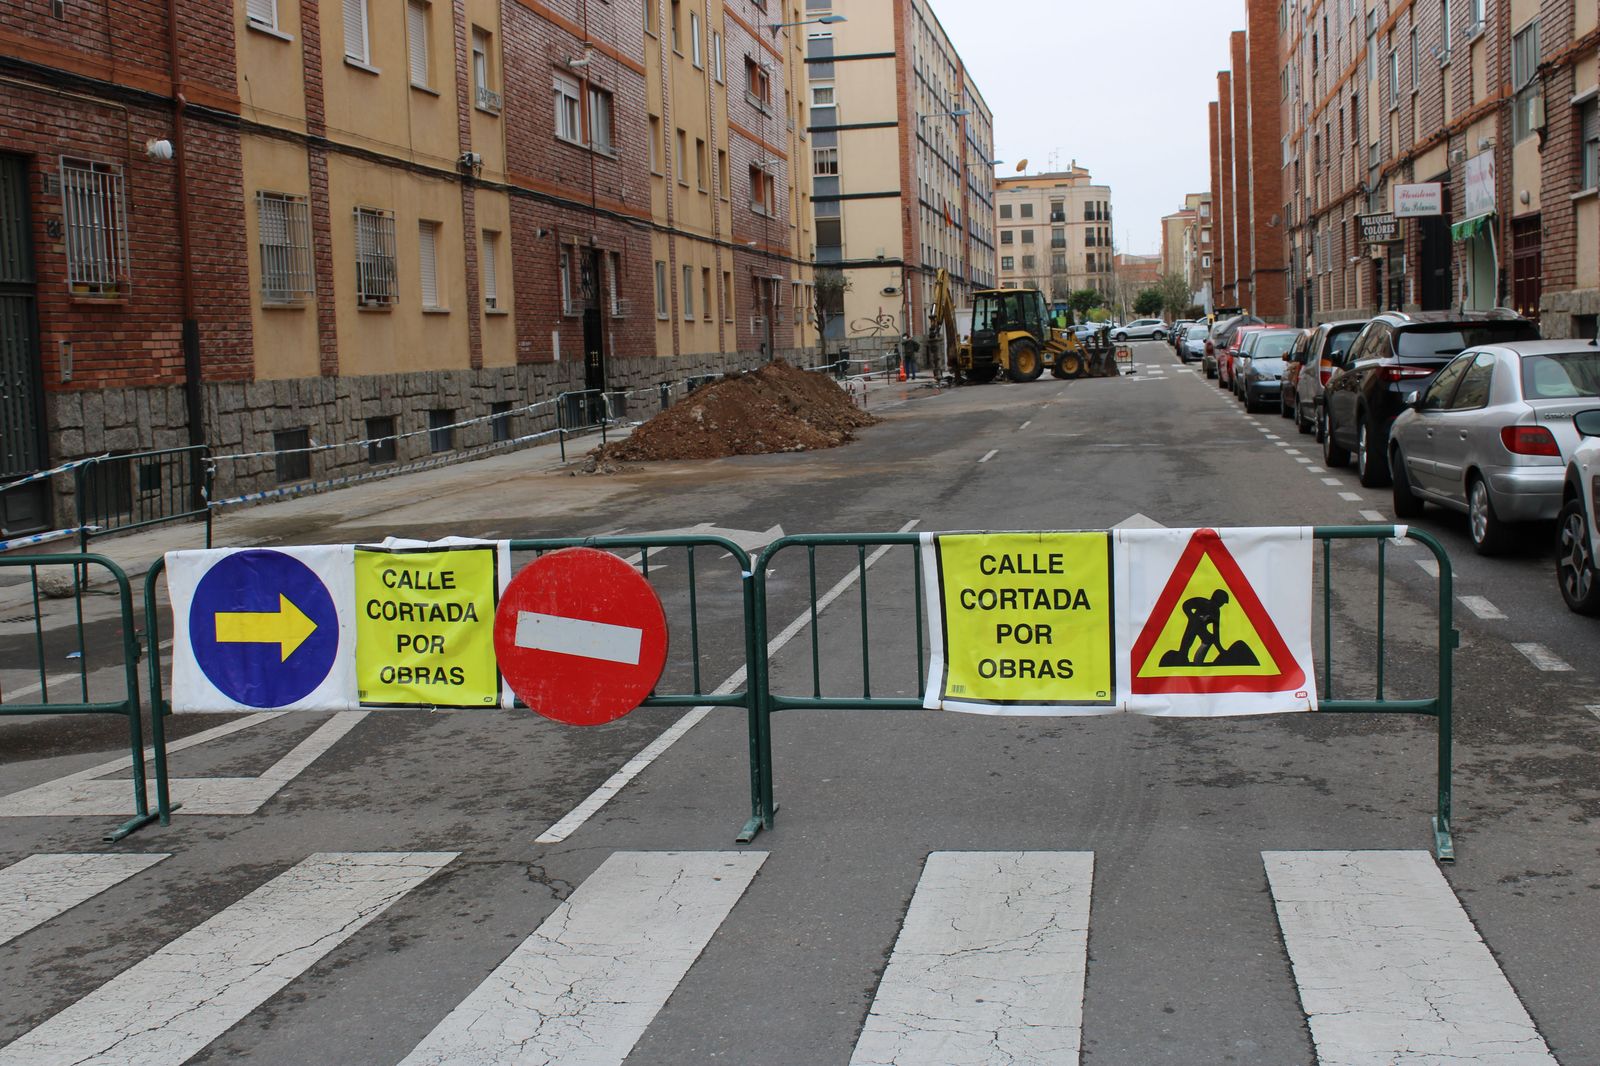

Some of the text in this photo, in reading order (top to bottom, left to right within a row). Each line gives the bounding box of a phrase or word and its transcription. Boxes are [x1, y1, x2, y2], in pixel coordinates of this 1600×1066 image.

[1364, 224, 1395, 236] COLORES
[979, 553, 1063, 575] CALLE
[382, 568, 456, 590] CALLE
[960, 588, 1091, 610] CORTADA
[366, 599, 478, 622] CORTADA
[397, 634, 444, 654] POR
[996, 623, 1052, 644] POR
[380, 666, 464, 685] OBRAS
[978, 658, 1073, 679] OBRAS
